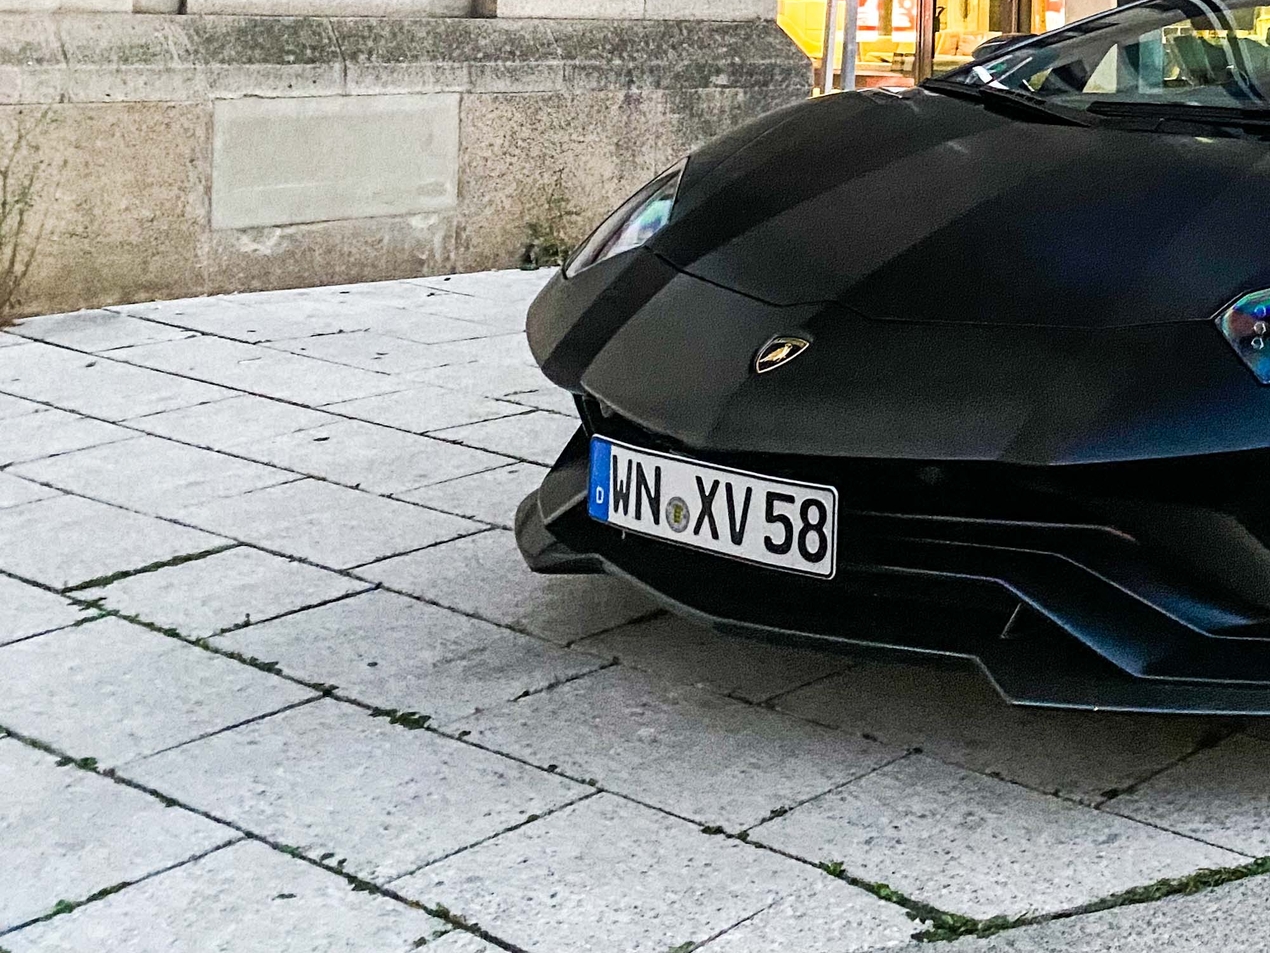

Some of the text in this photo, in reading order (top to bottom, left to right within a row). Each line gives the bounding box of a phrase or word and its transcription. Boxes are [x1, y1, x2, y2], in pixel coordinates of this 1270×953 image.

[612, 454, 828, 563] WN XV 58
